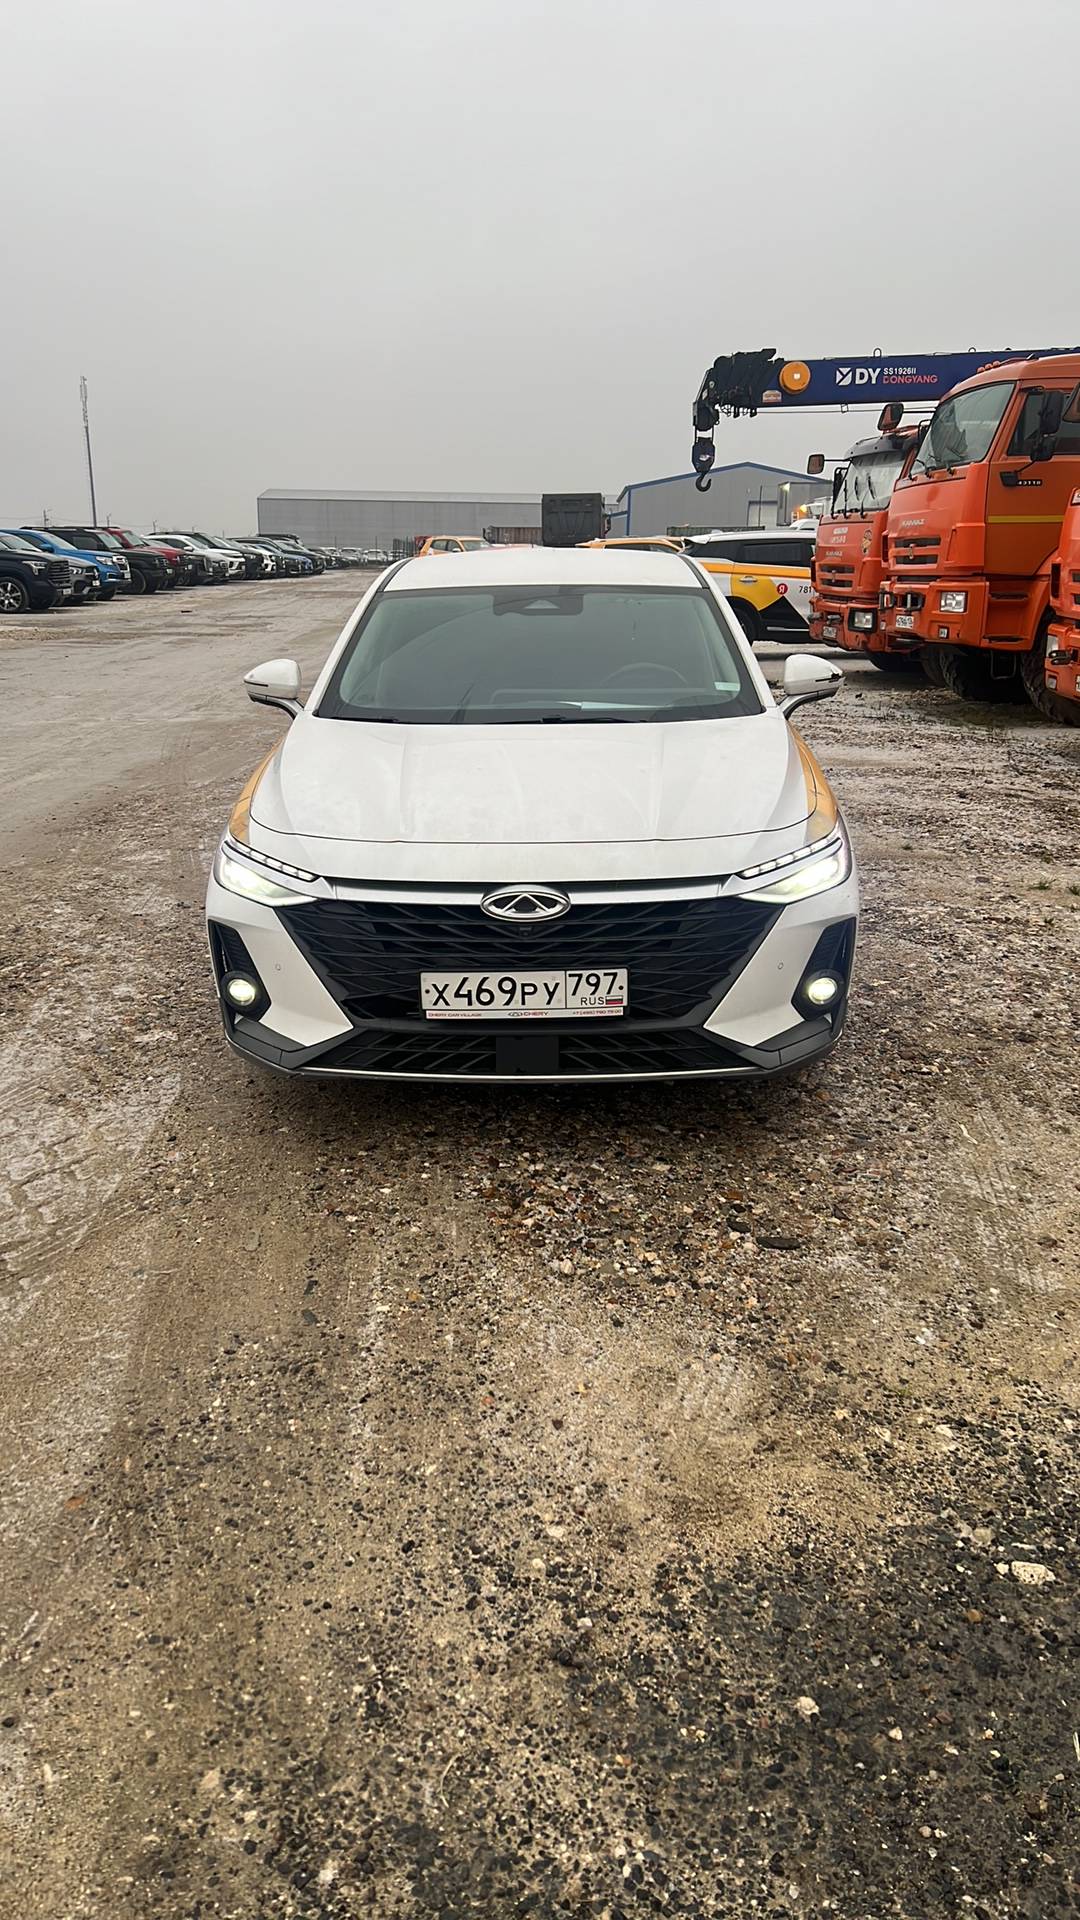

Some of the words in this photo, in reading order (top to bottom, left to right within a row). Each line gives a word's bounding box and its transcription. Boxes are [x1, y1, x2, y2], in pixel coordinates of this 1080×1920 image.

[855, 368, 881, 385] DY
[883, 375, 938, 384] DONGYANG
[568, 972, 618, 997] 797
[580, 996, 605, 1006] RUS
